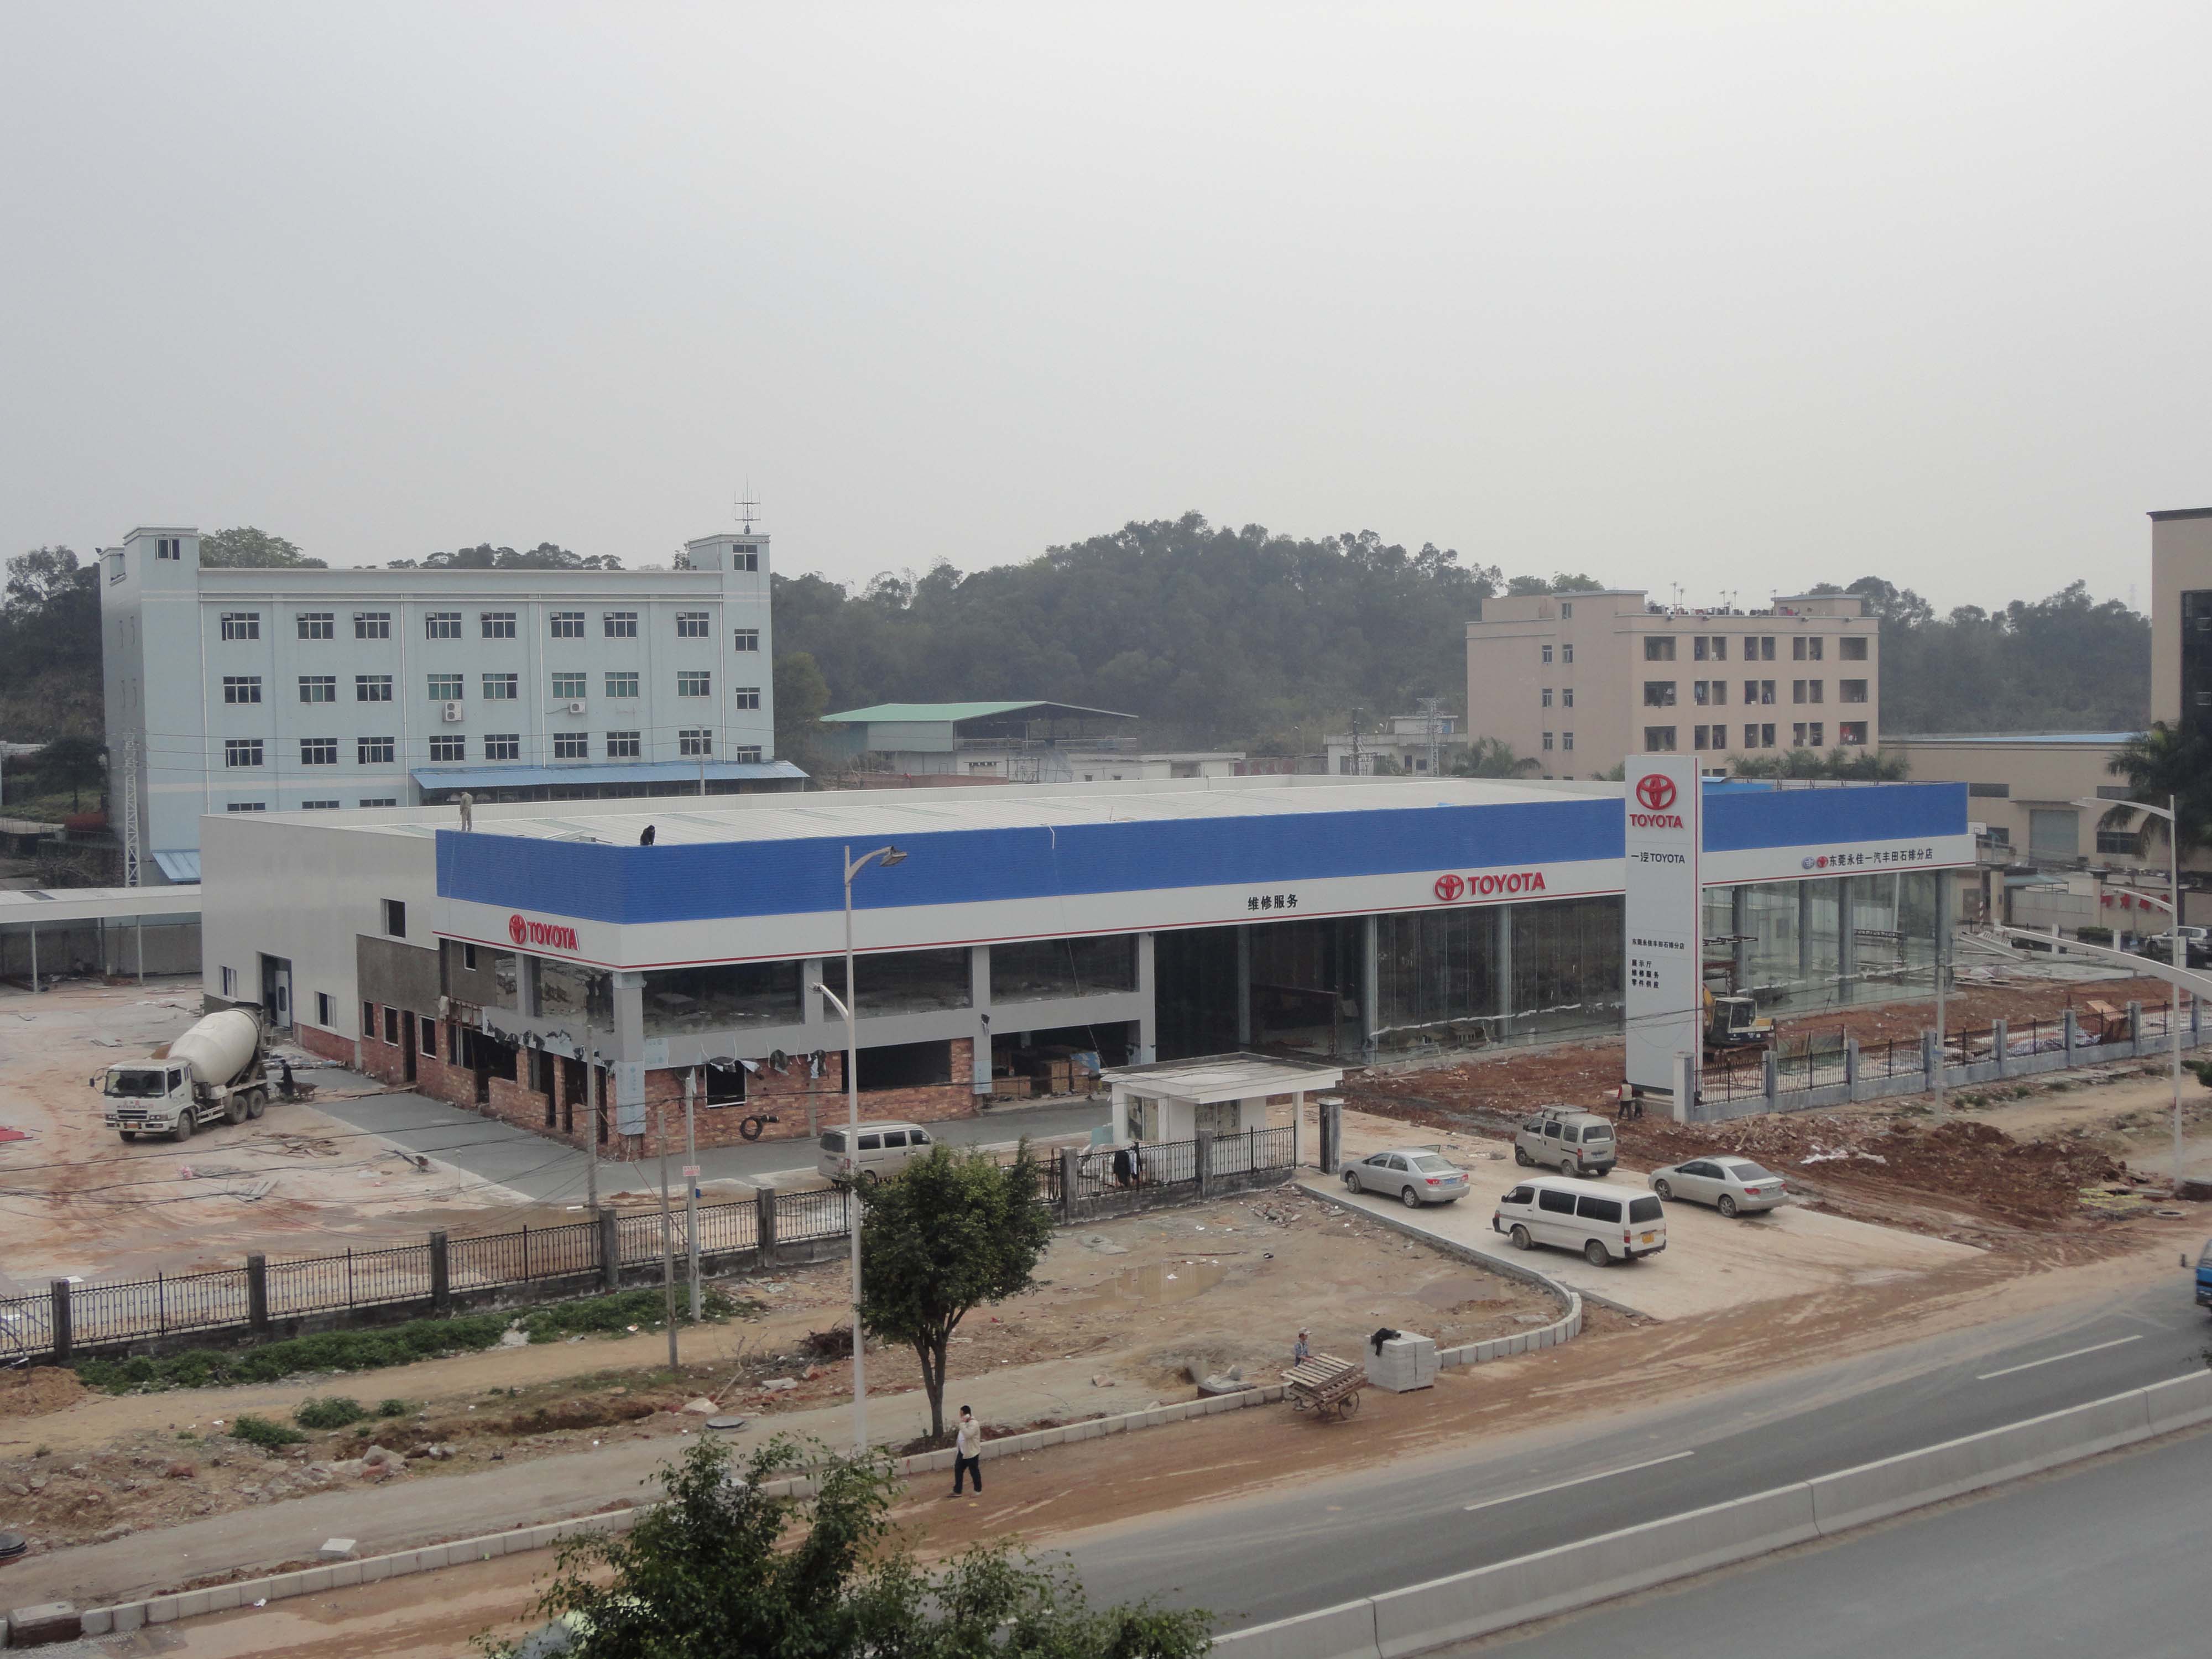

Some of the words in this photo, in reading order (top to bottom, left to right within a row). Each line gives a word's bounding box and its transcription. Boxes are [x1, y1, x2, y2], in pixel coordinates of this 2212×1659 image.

[1629, 813, 1684, 829] TOYOTA
[1829, 848, 1934, 867] 东莞永佳一汽丰田石排分店
[1468, 872, 1546, 895] TOYOTA
[1248, 894, 1298, 911] 维修服务
[526, 921, 580, 951] TOYOTA
